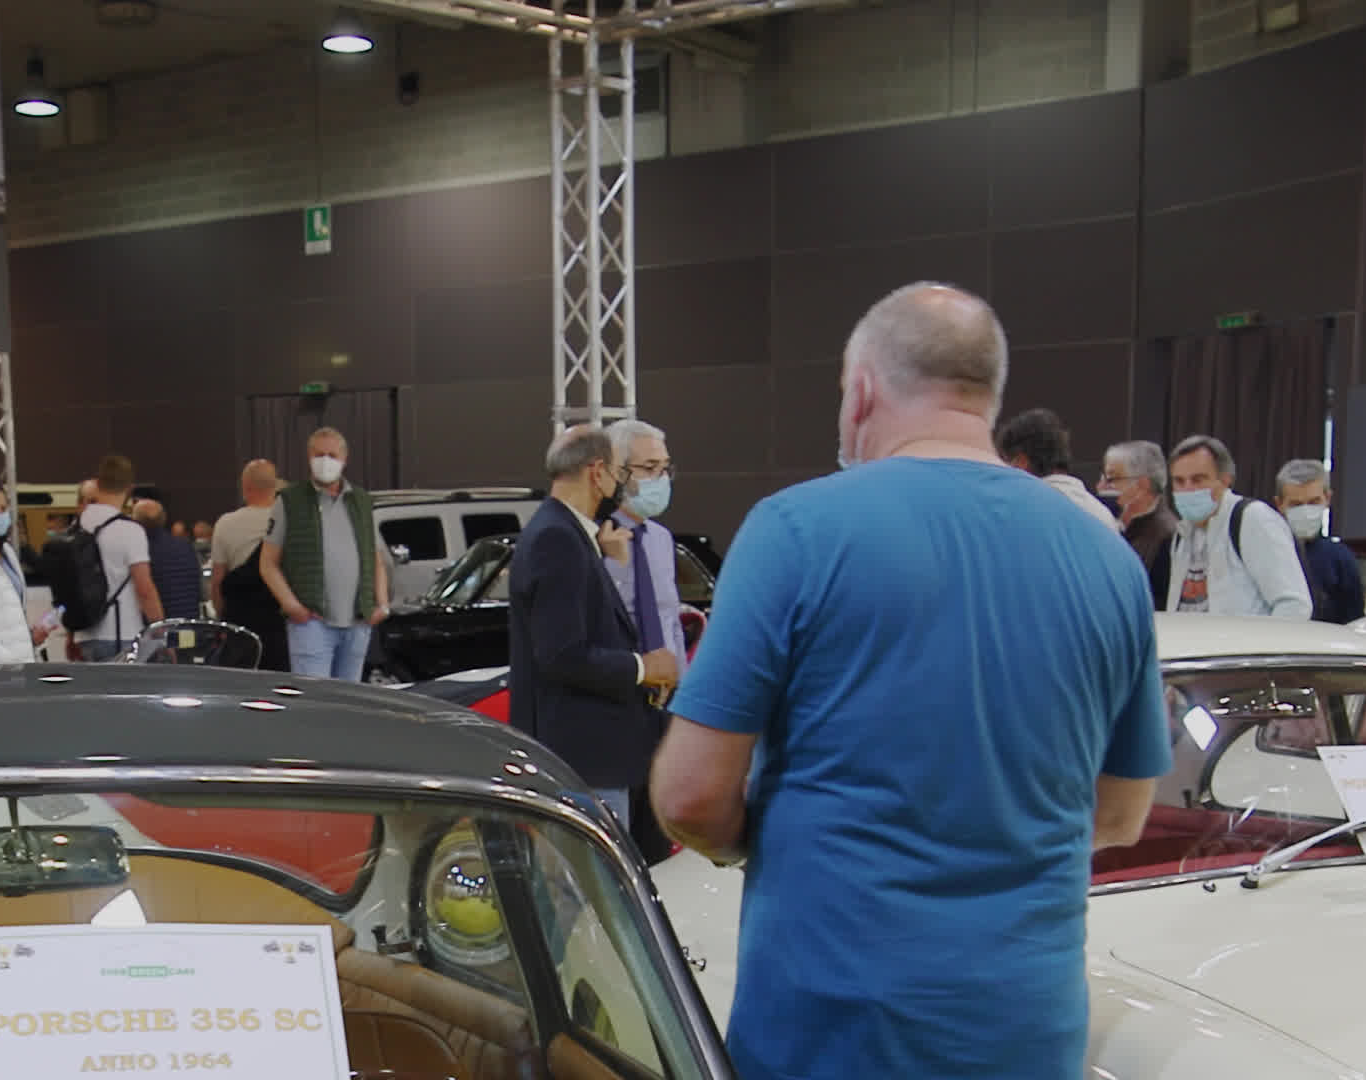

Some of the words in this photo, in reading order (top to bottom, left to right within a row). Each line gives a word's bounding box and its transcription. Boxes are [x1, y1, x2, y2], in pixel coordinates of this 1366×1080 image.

[191, 1008, 261, 1032] 356
[275, 1008, 324, 1033] SC
[80, 1054, 157, 1074] ANNO
[169, 1053, 233, 1072] 1964
